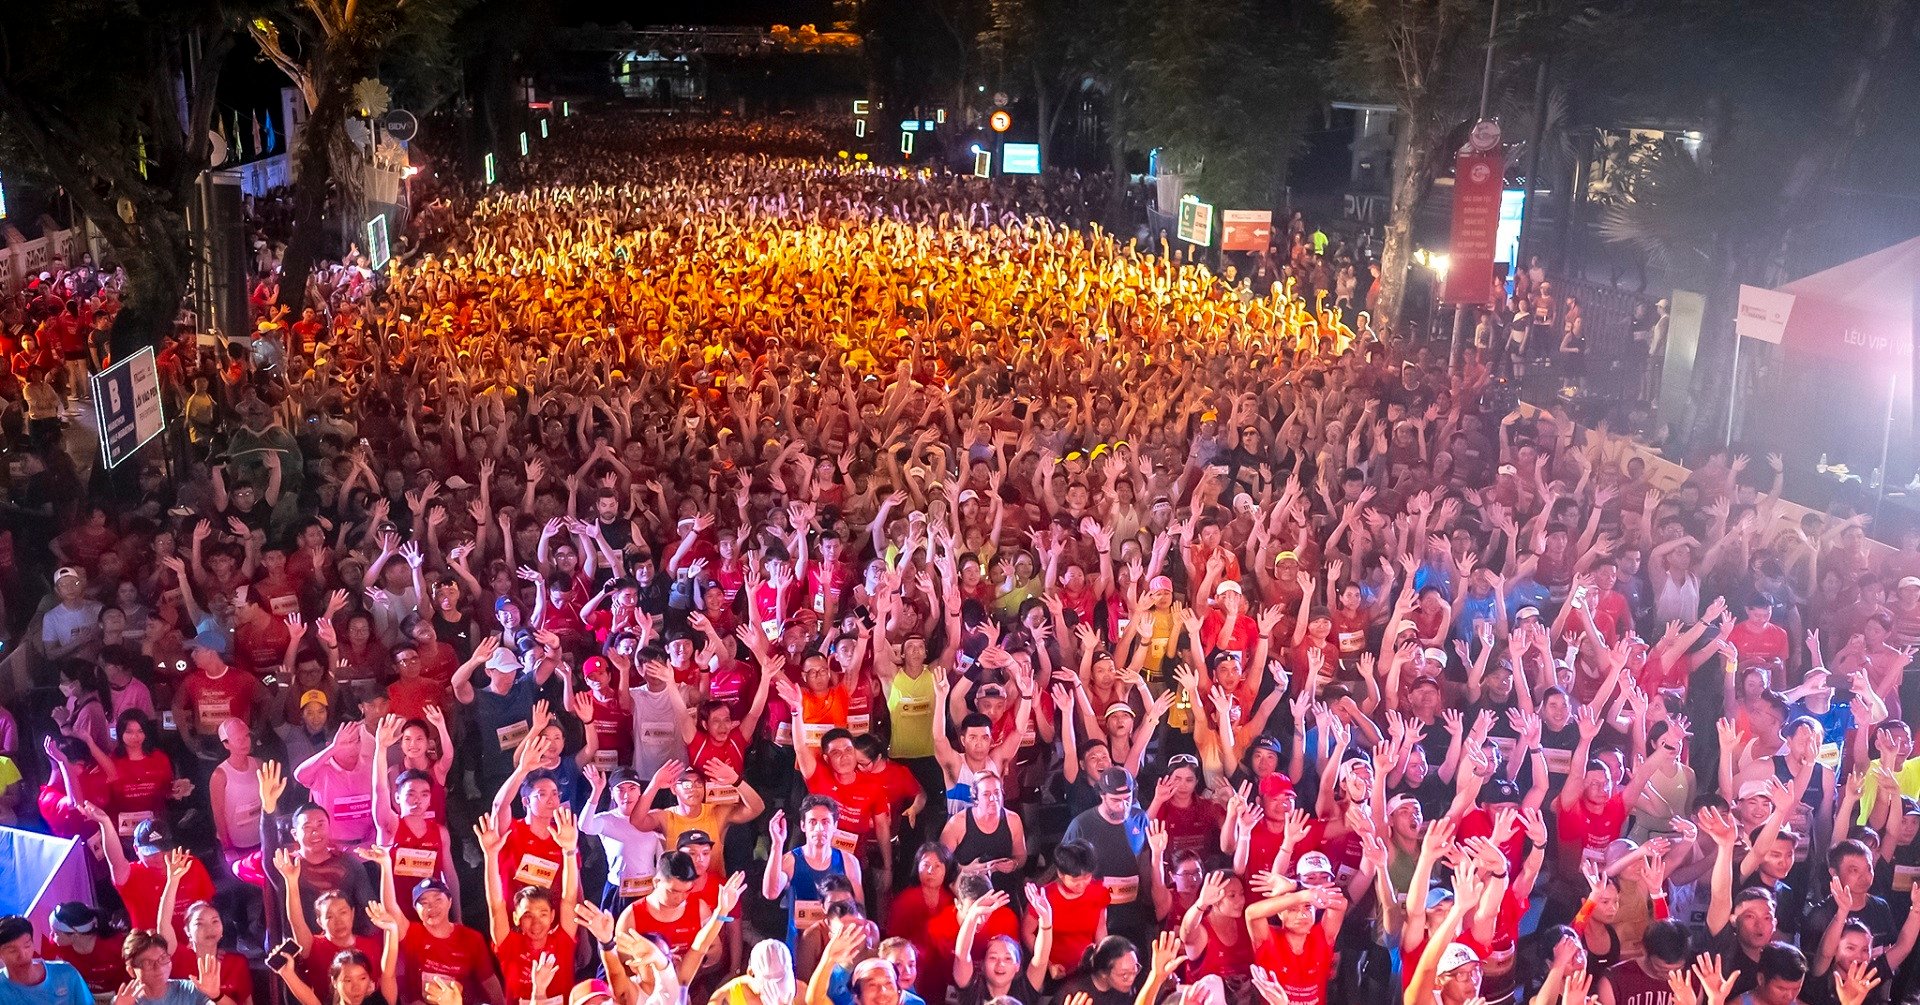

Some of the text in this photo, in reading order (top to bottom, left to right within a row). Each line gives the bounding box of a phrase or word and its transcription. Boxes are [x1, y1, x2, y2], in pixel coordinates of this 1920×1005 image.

[108, 378, 121, 414] B
[708, 789, 715, 797] A
[398, 857, 406, 866] A
[521, 864, 529, 873] A
[623, 880, 629, 888] E
[798, 910, 806, 919] B
